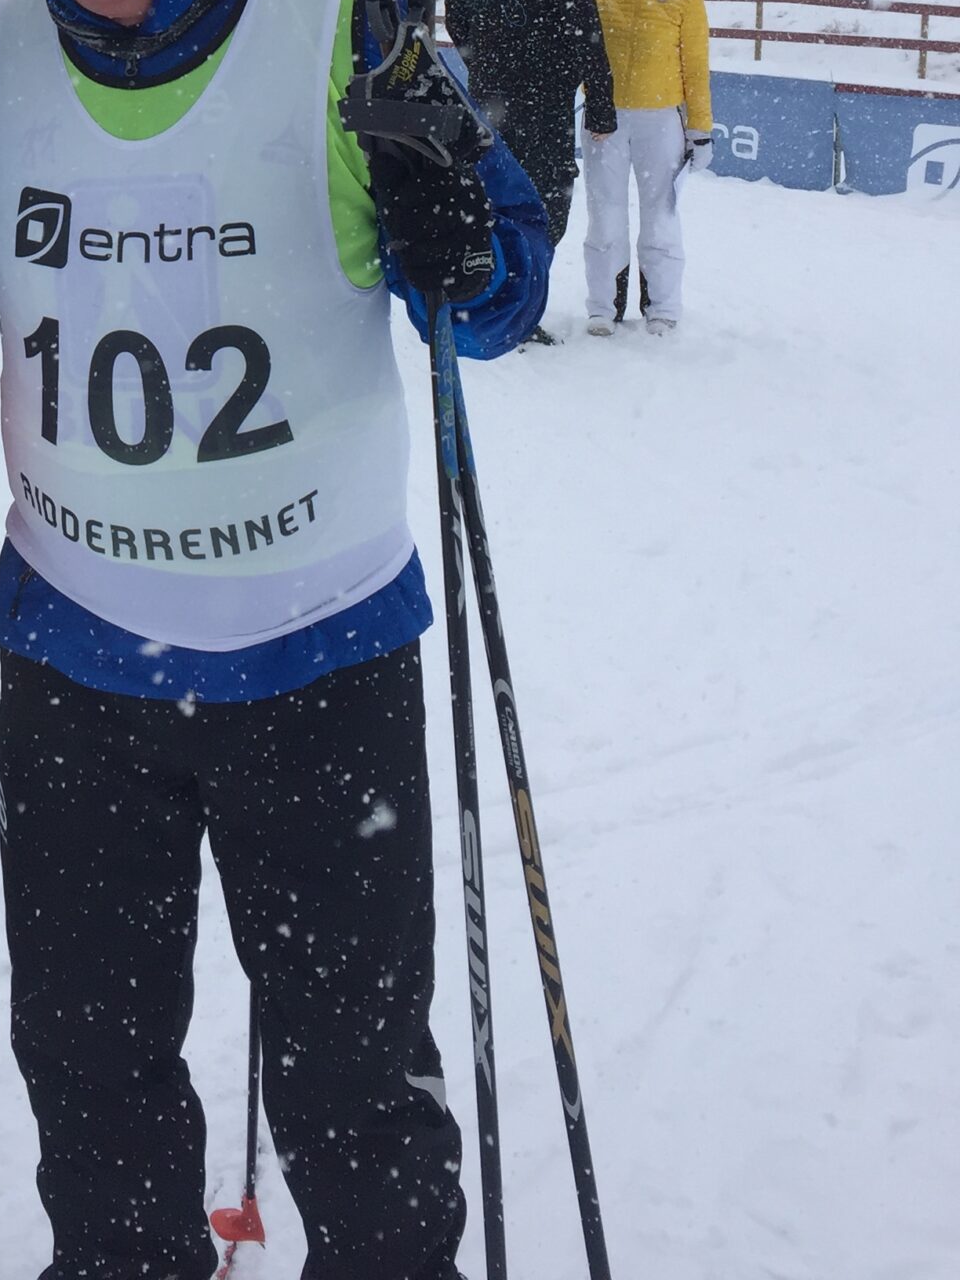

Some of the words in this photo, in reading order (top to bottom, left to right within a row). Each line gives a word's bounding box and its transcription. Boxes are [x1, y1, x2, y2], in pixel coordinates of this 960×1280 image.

[79, 221, 257, 263] entra
[23, 316, 294, 466] 102
[20, 472, 319, 561] RIDDERRENNET
[505, 706, 524, 780] CARBON
[462, 809, 493, 1095] SWIX
[515, 788, 575, 1068] SWIX
